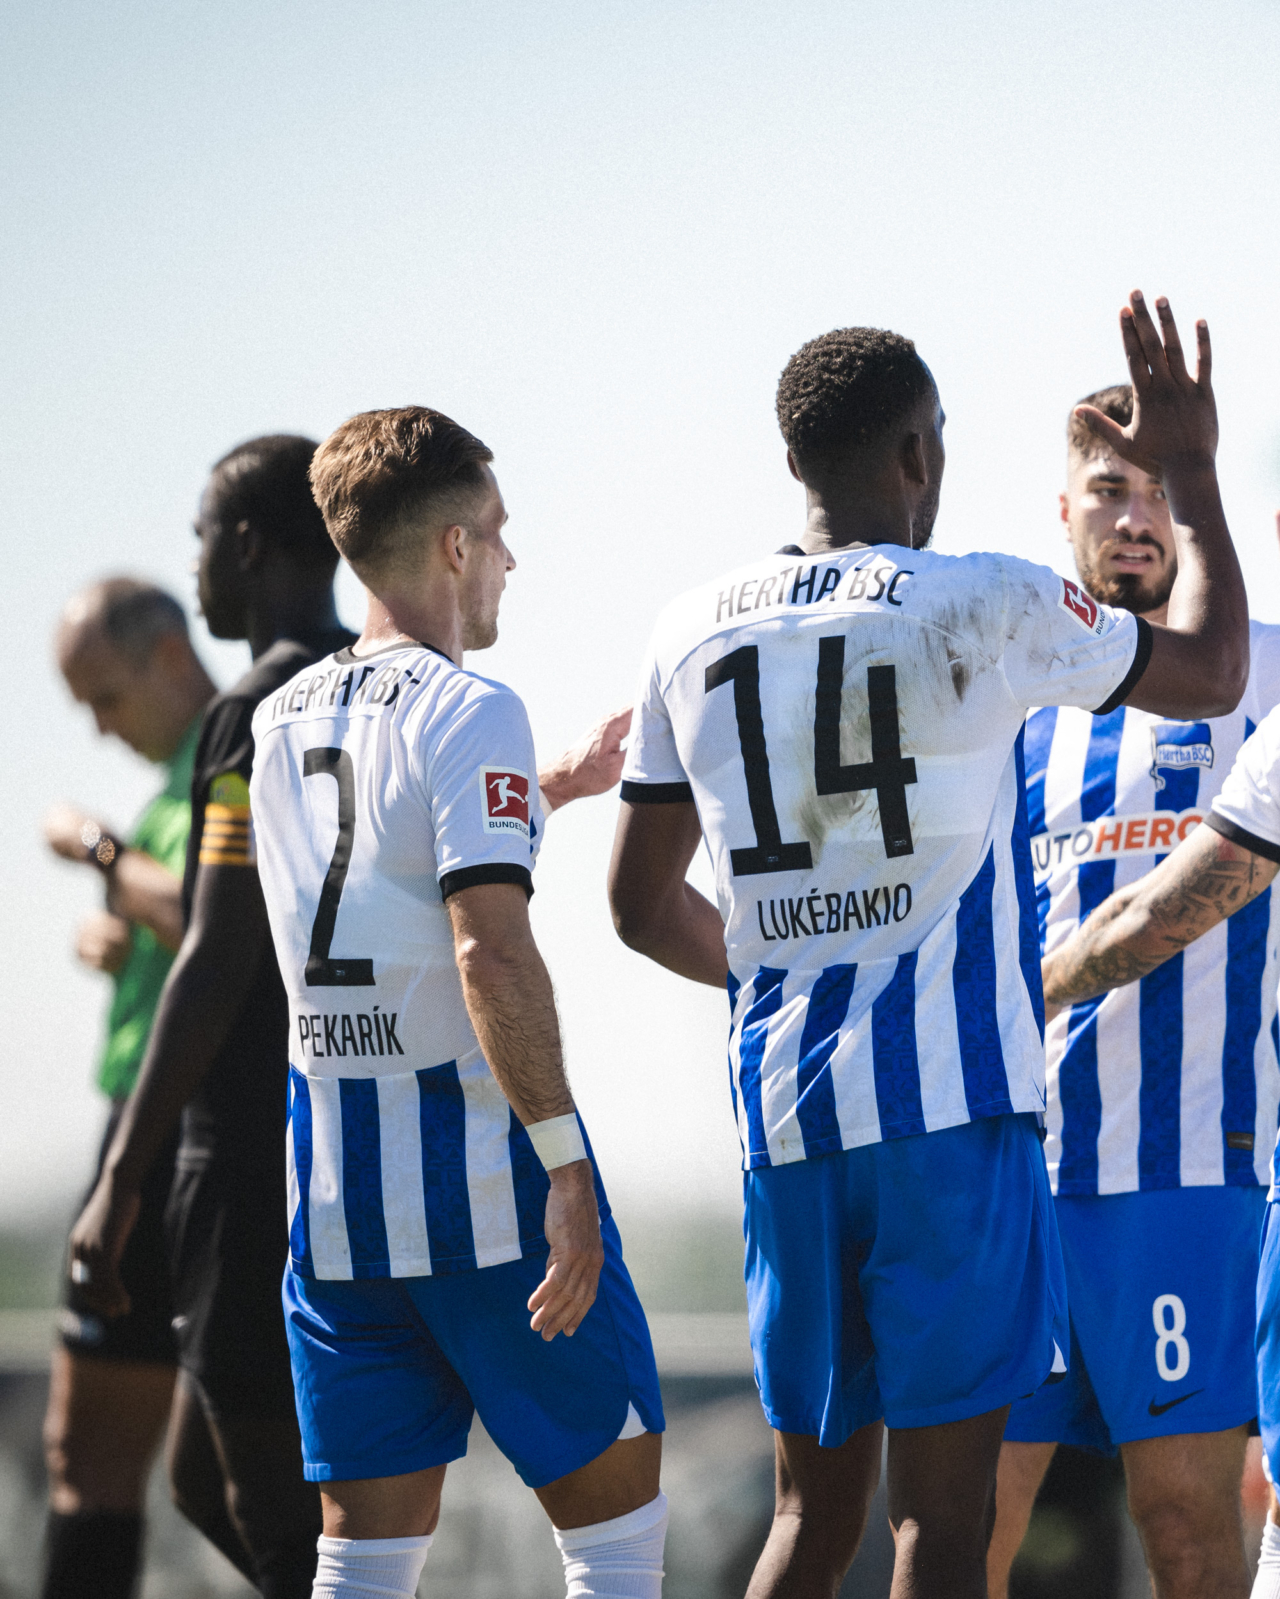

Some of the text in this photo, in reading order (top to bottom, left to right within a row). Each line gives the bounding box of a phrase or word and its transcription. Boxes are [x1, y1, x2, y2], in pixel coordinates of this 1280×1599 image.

[716, 564, 914, 623] HERTHA BSC
[705, 635, 918, 878] 14
[1191, 745, 1210, 762] BSC
[303, 746, 376, 987] 2
[757, 883, 912, 941] LUKÉBAKIO
[298, 1006, 405, 1057] PEKARÍK
[1152, 1293, 1190, 1381] 8
